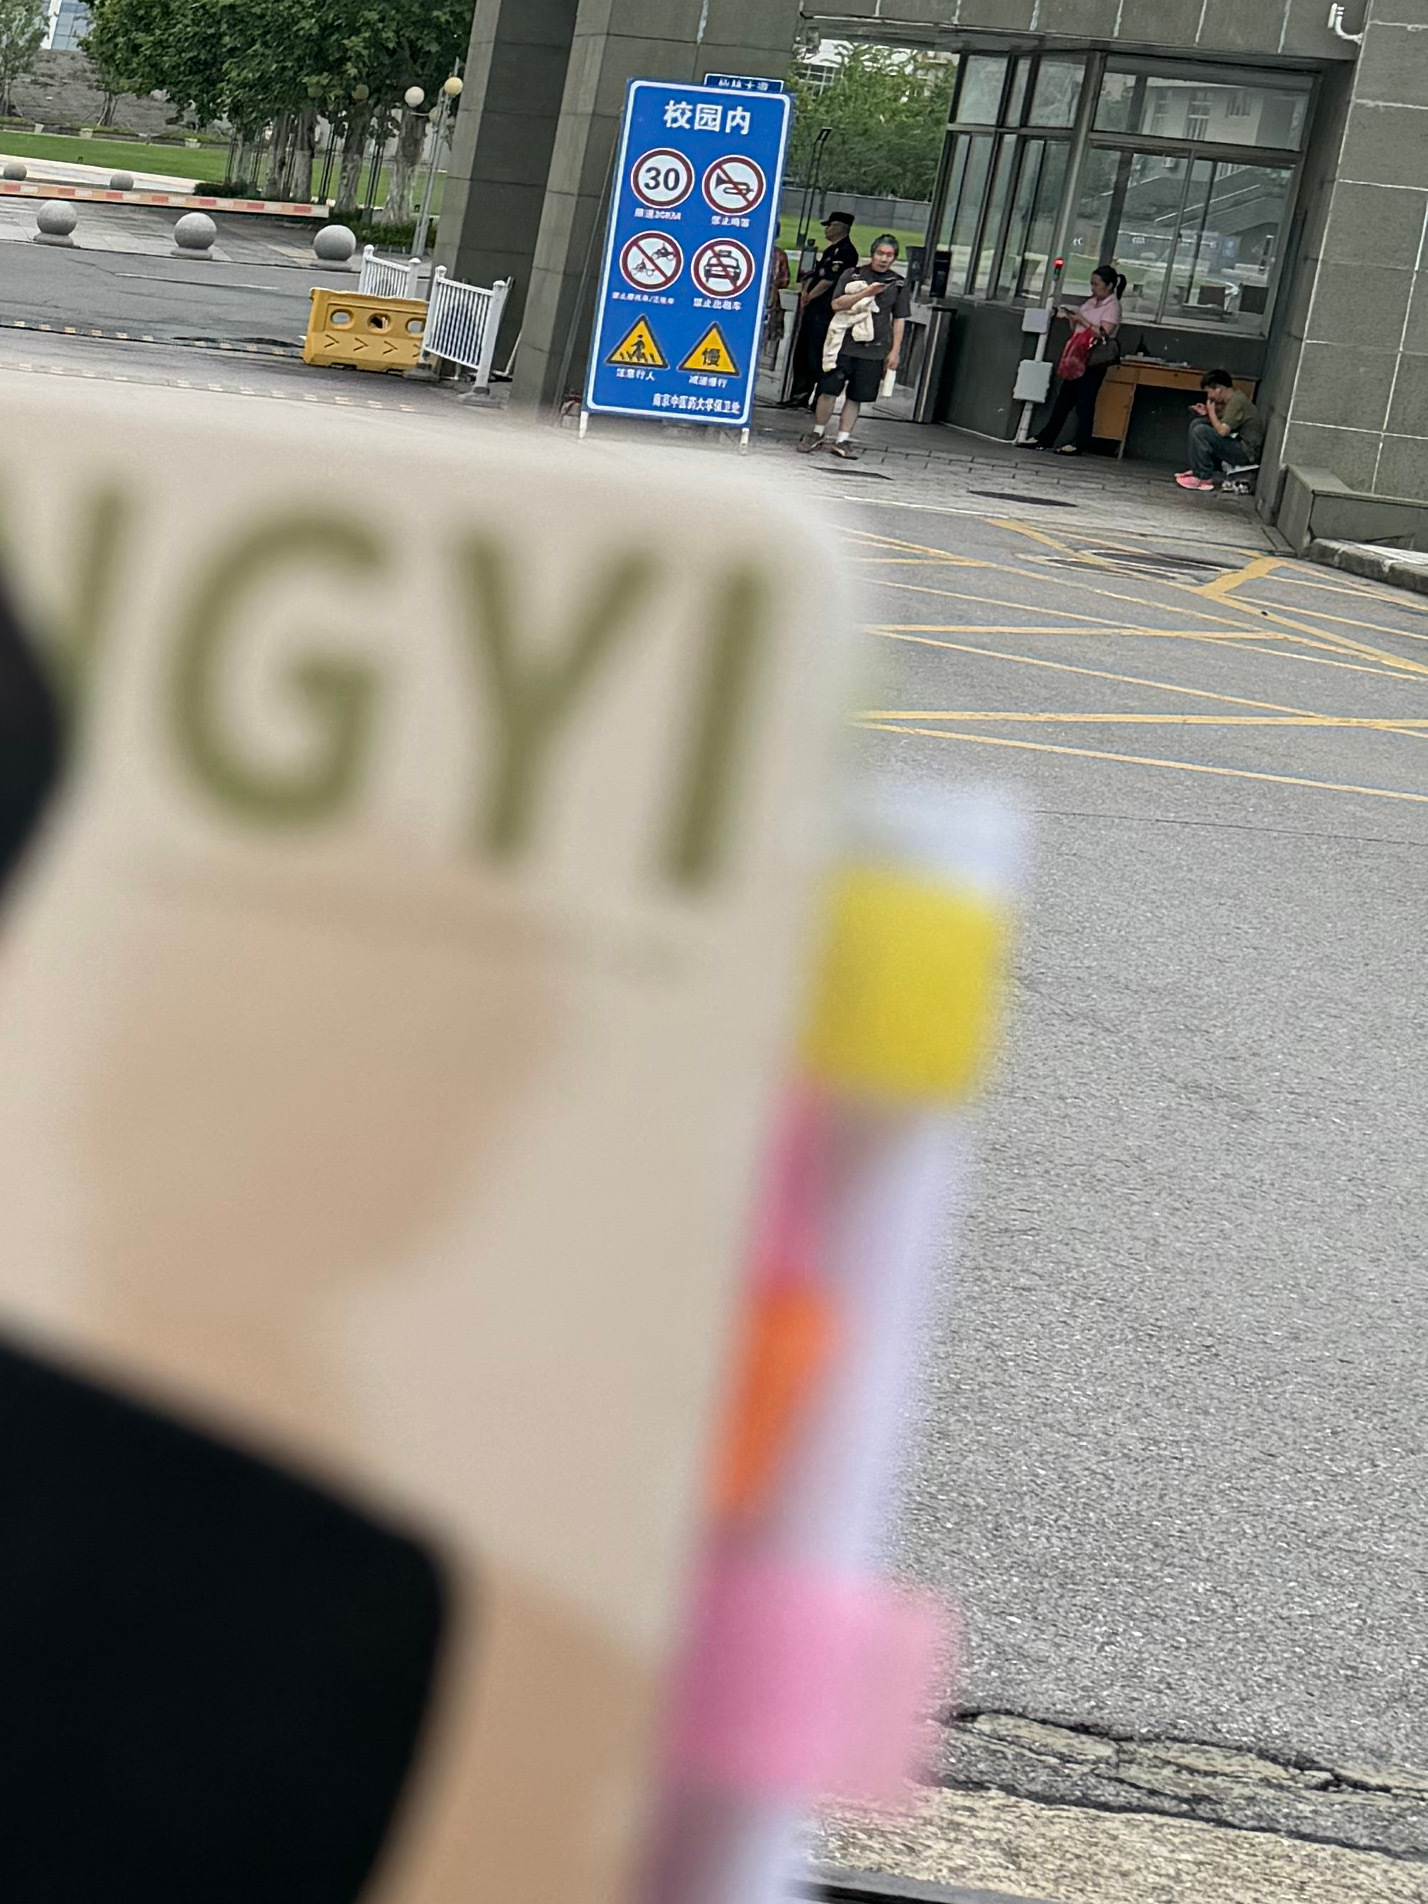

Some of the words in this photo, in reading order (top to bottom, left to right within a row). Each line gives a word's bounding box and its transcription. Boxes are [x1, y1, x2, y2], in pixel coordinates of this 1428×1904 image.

[662, 100, 751, 135] 校园内
[643, 166, 681, 192] 30
